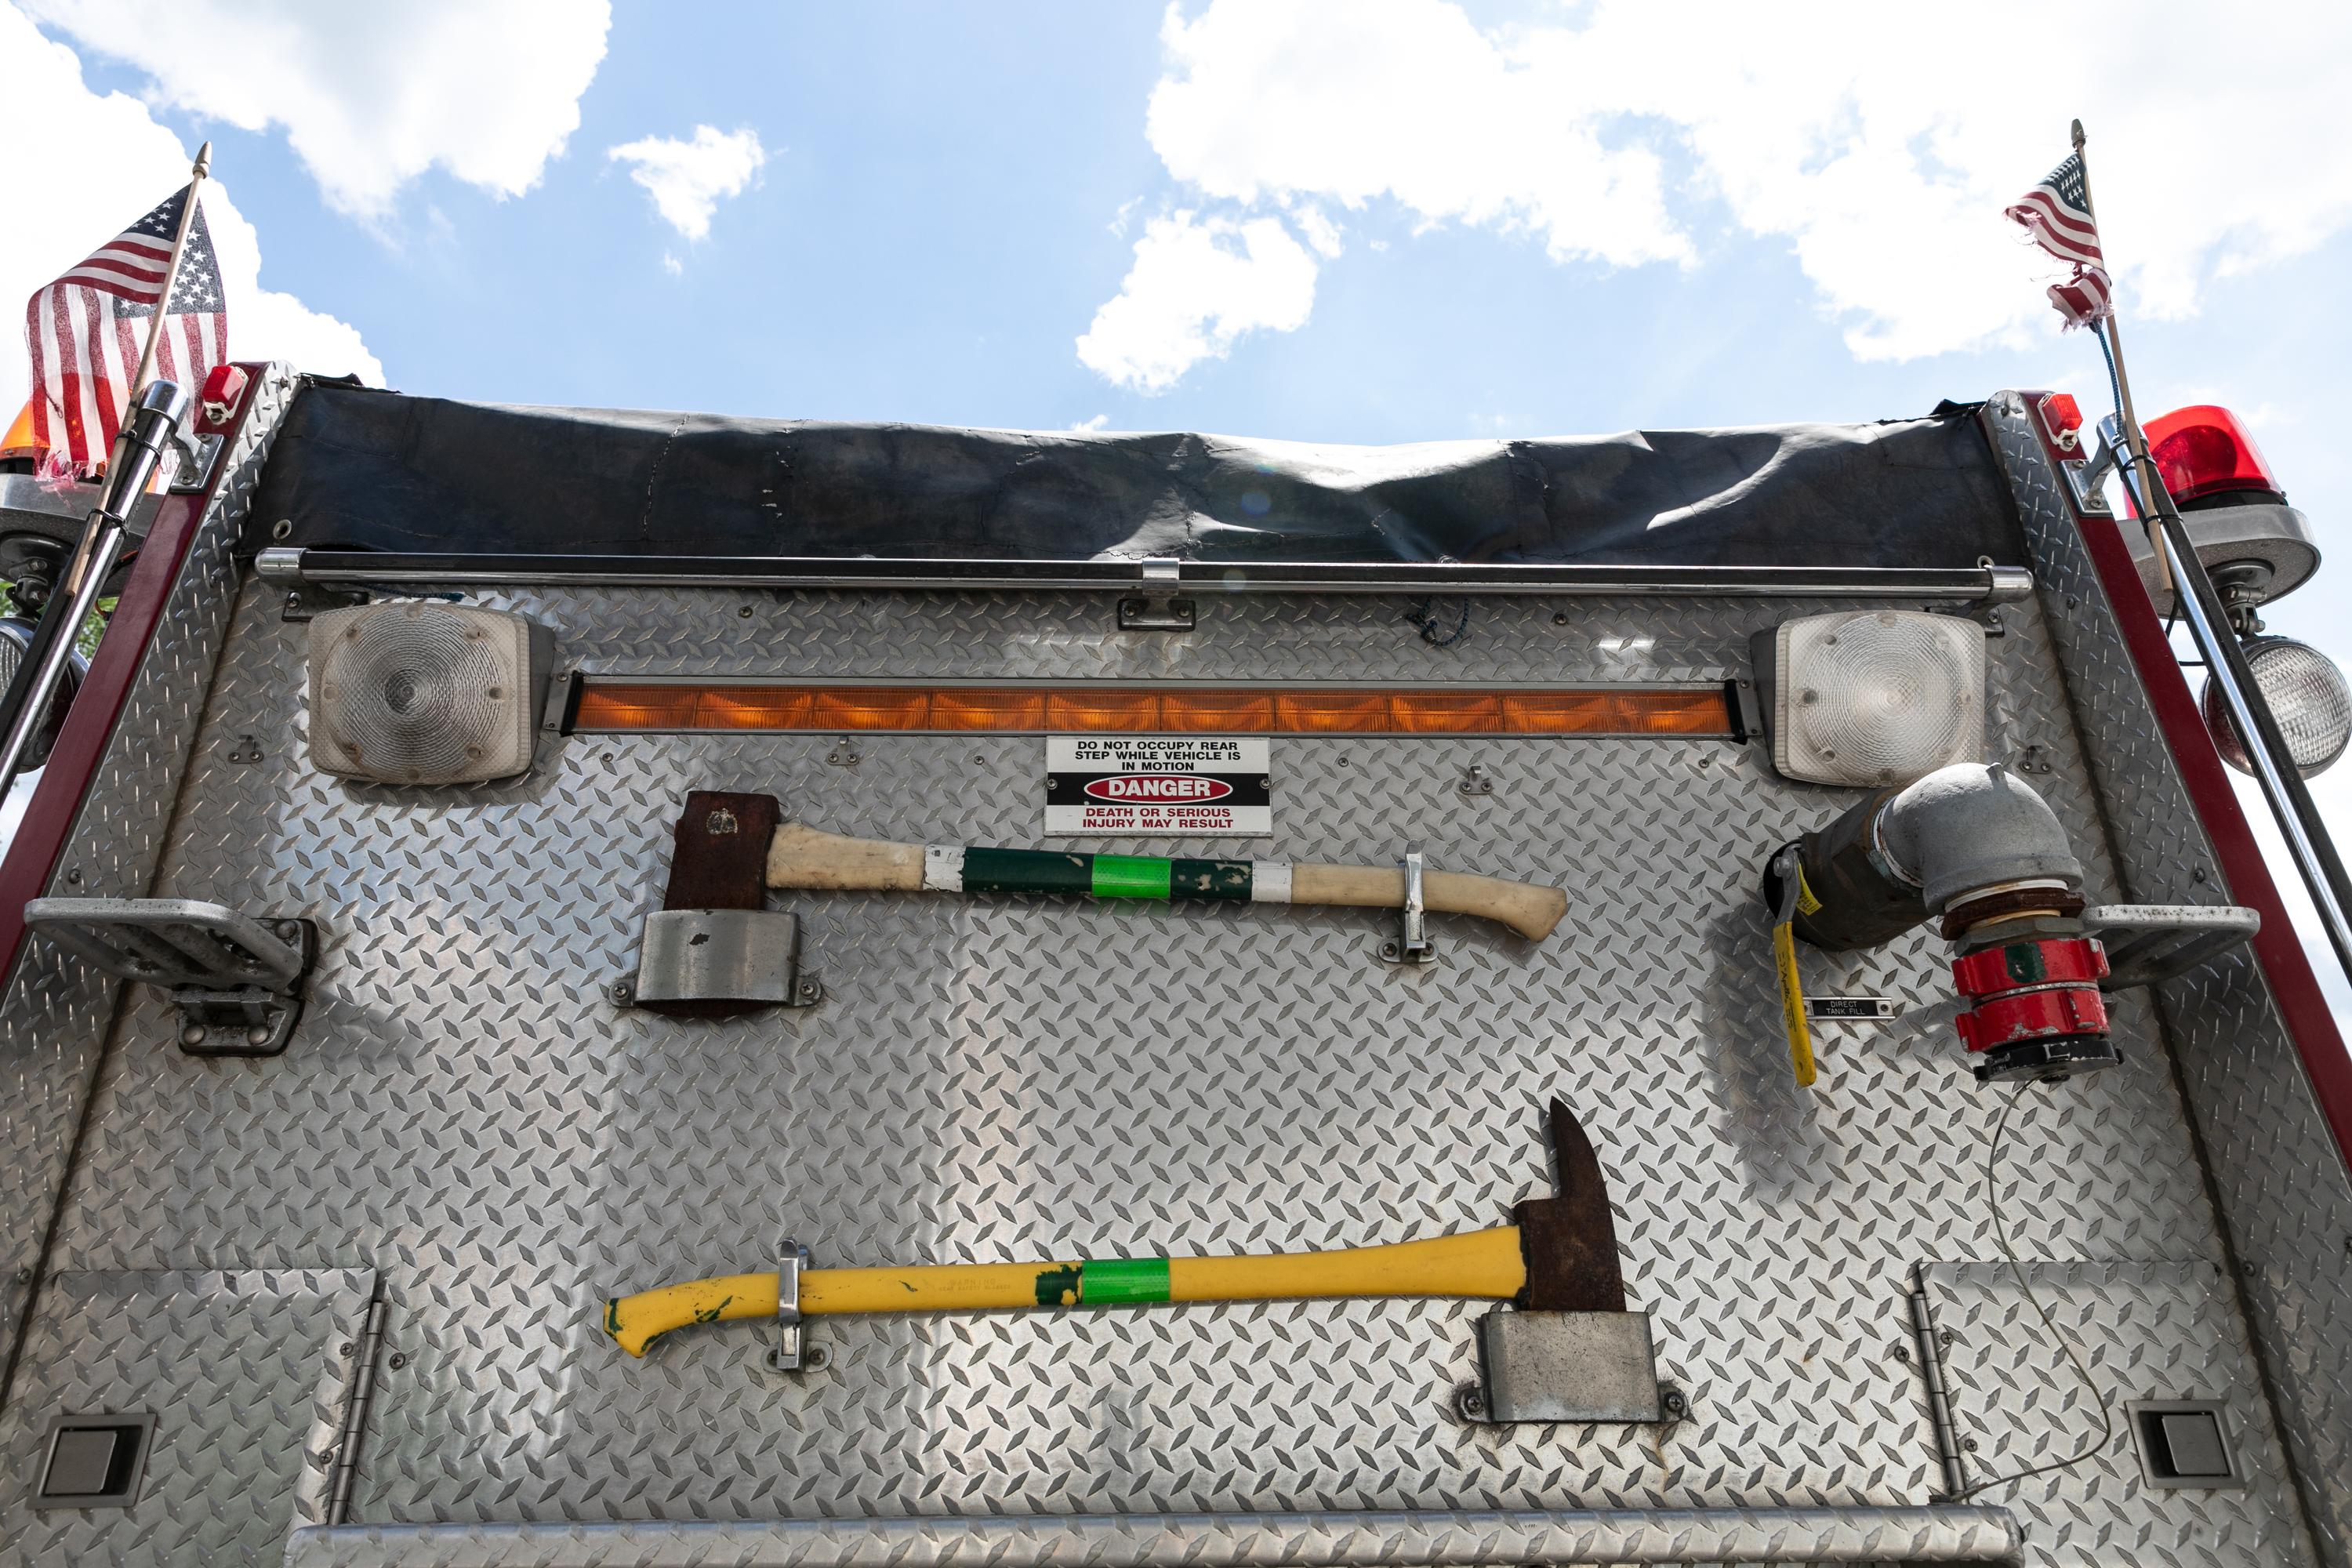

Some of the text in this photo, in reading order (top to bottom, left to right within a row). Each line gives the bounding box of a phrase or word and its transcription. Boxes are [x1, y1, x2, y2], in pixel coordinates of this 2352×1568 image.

[1077, 741, 1238, 750] DO NOT OCCUPY REAR
[1075, 751, 1110, 760] STEP
[1116, 751, 1158, 760] WHILE
[1228, 752, 1241, 760] IS
[1121, 762, 1194, 771] IN MOTION
[1109, 780, 1210, 797] DANGER
[1086, 808, 1231, 817] DEATH OR SERIOUS
[1083, 819, 1233, 828] INJURY MAY RESULT
